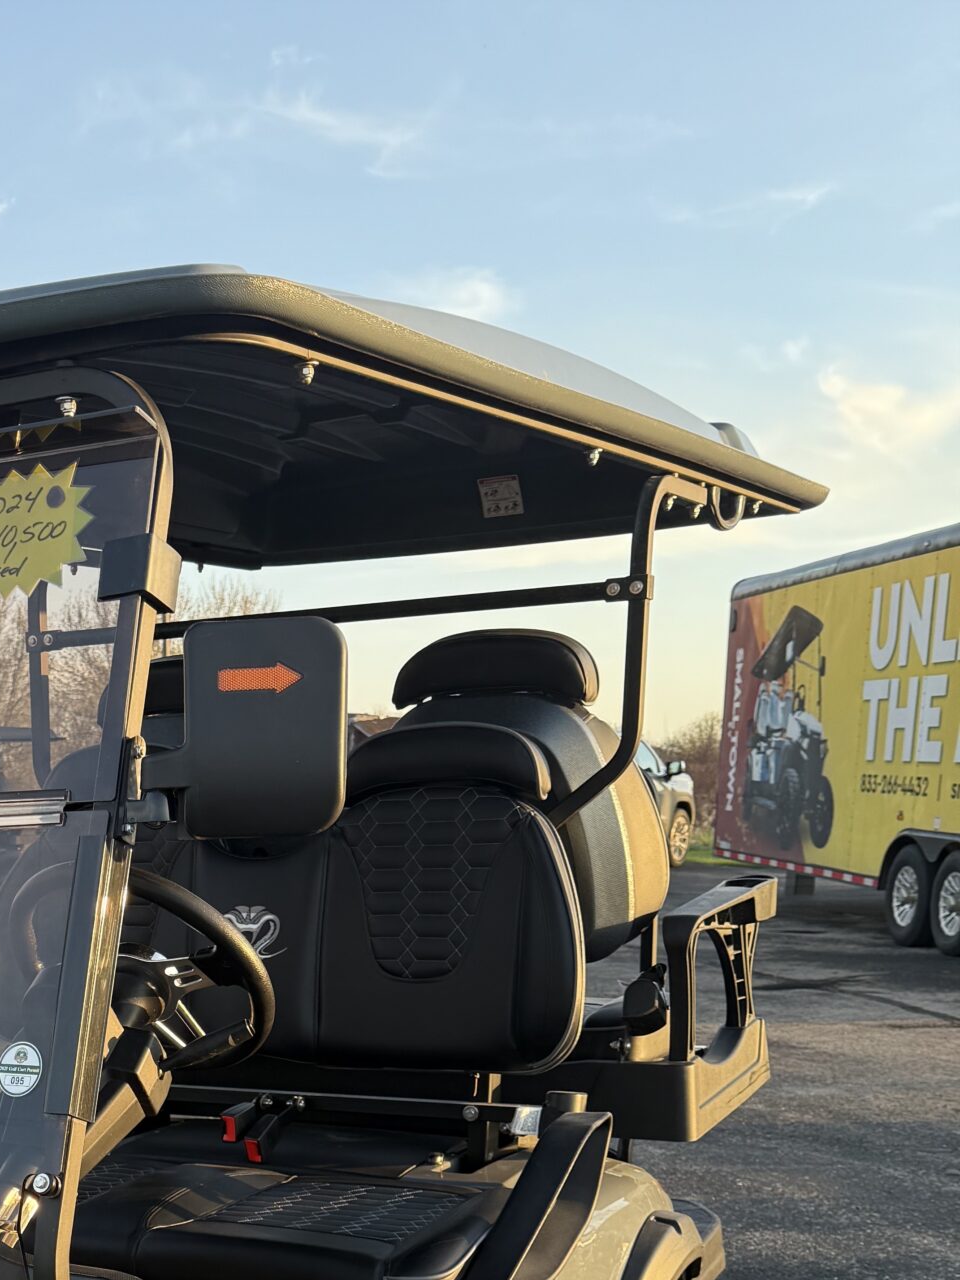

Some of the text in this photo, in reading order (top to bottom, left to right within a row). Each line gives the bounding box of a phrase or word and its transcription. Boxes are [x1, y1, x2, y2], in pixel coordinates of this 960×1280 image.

[869, 573, 958, 671] UNL
[862, 674, 949, 763] THE
[10, 1076, 24, 1085] 095
